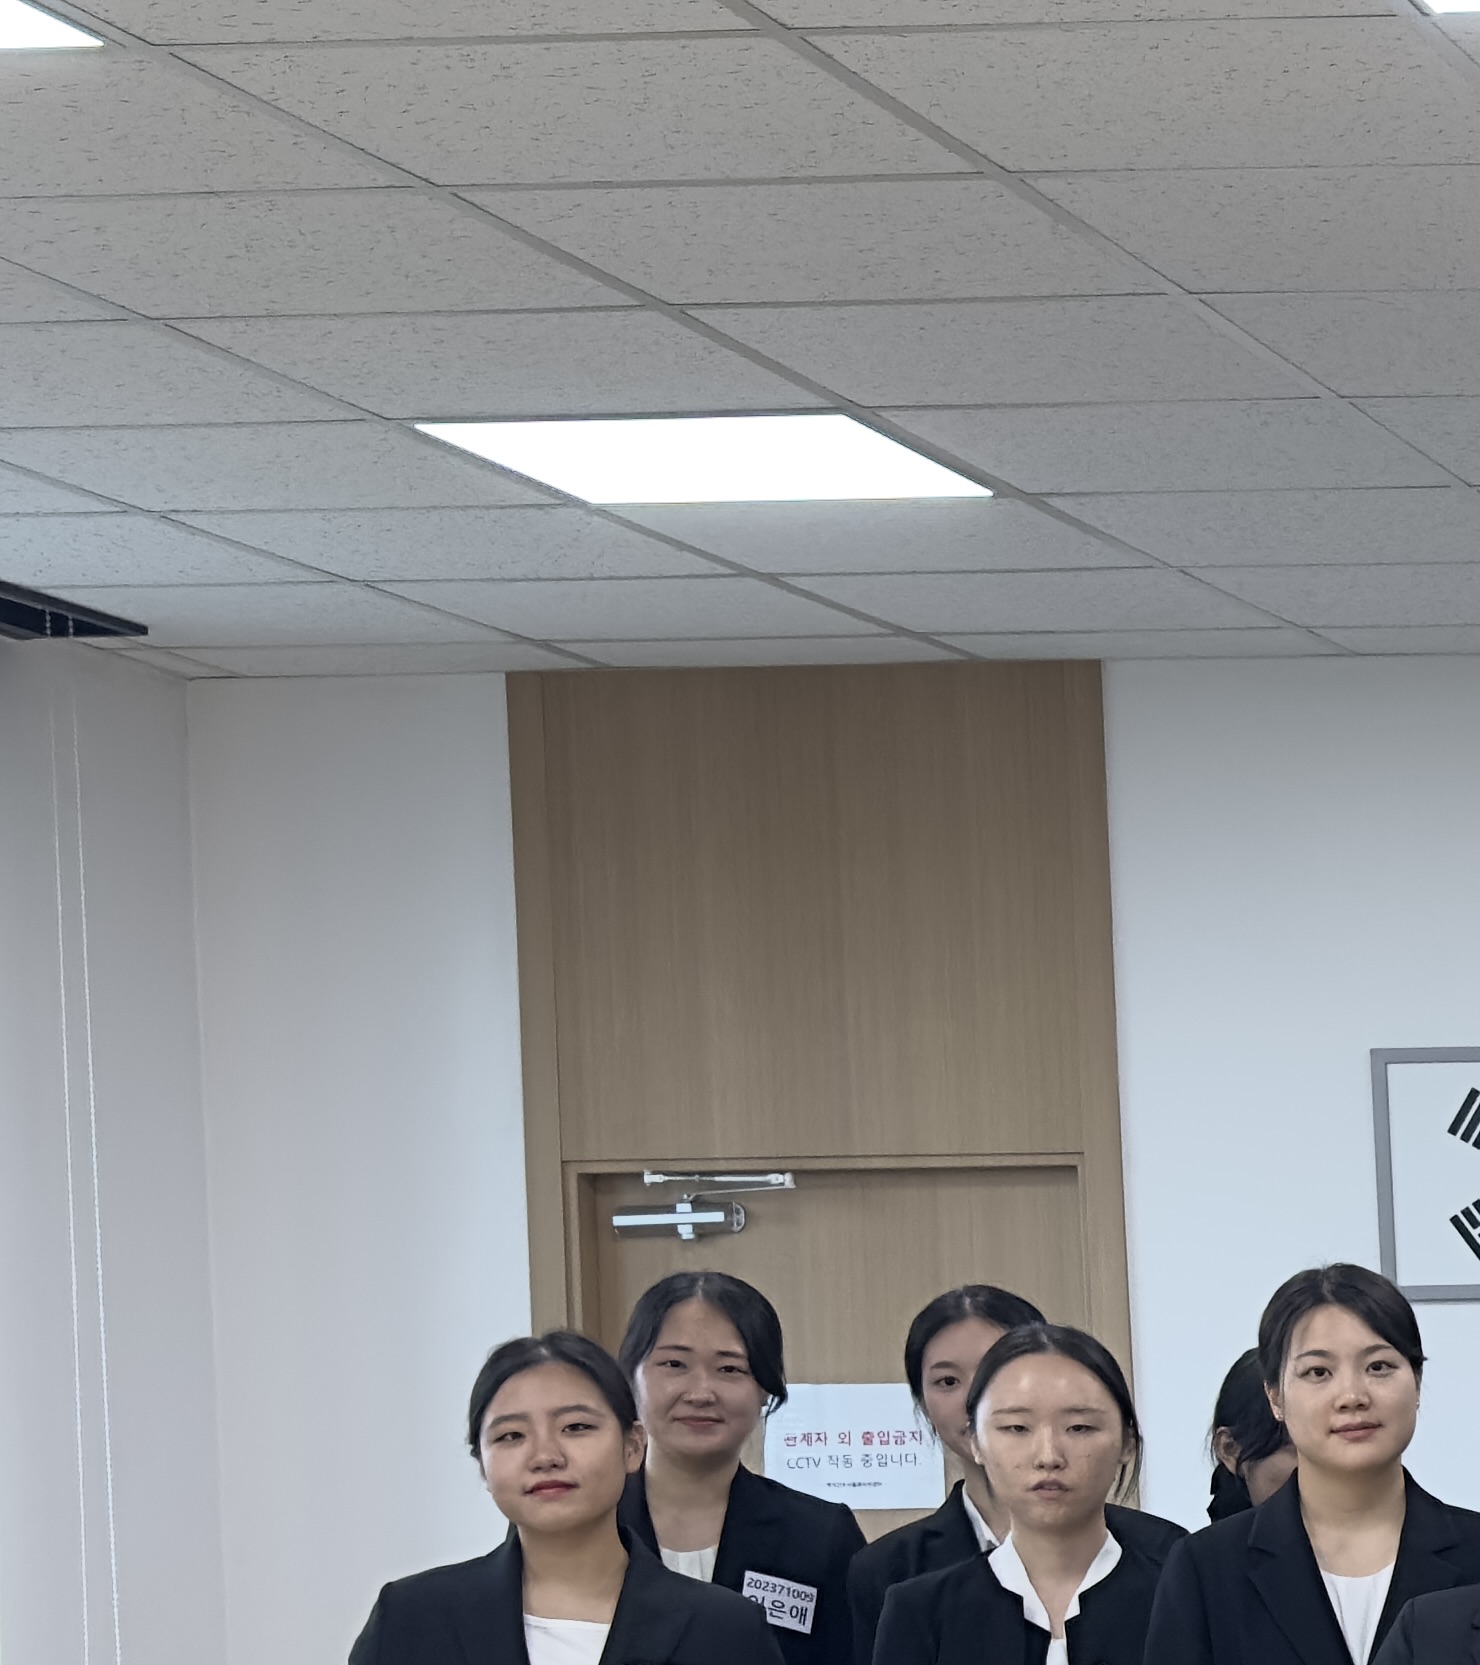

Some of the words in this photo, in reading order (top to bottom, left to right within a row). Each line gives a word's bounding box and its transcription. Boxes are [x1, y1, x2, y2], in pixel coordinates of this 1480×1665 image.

[837, 1430, 852, 1447] 외
[861, 1429, 923, 1447] 출입금지
[786, 1456, 822, 1469] CCTV
[827, 1453, 853, 1469] 작동
[860, 1452, 923, 1469] 중입니다.
